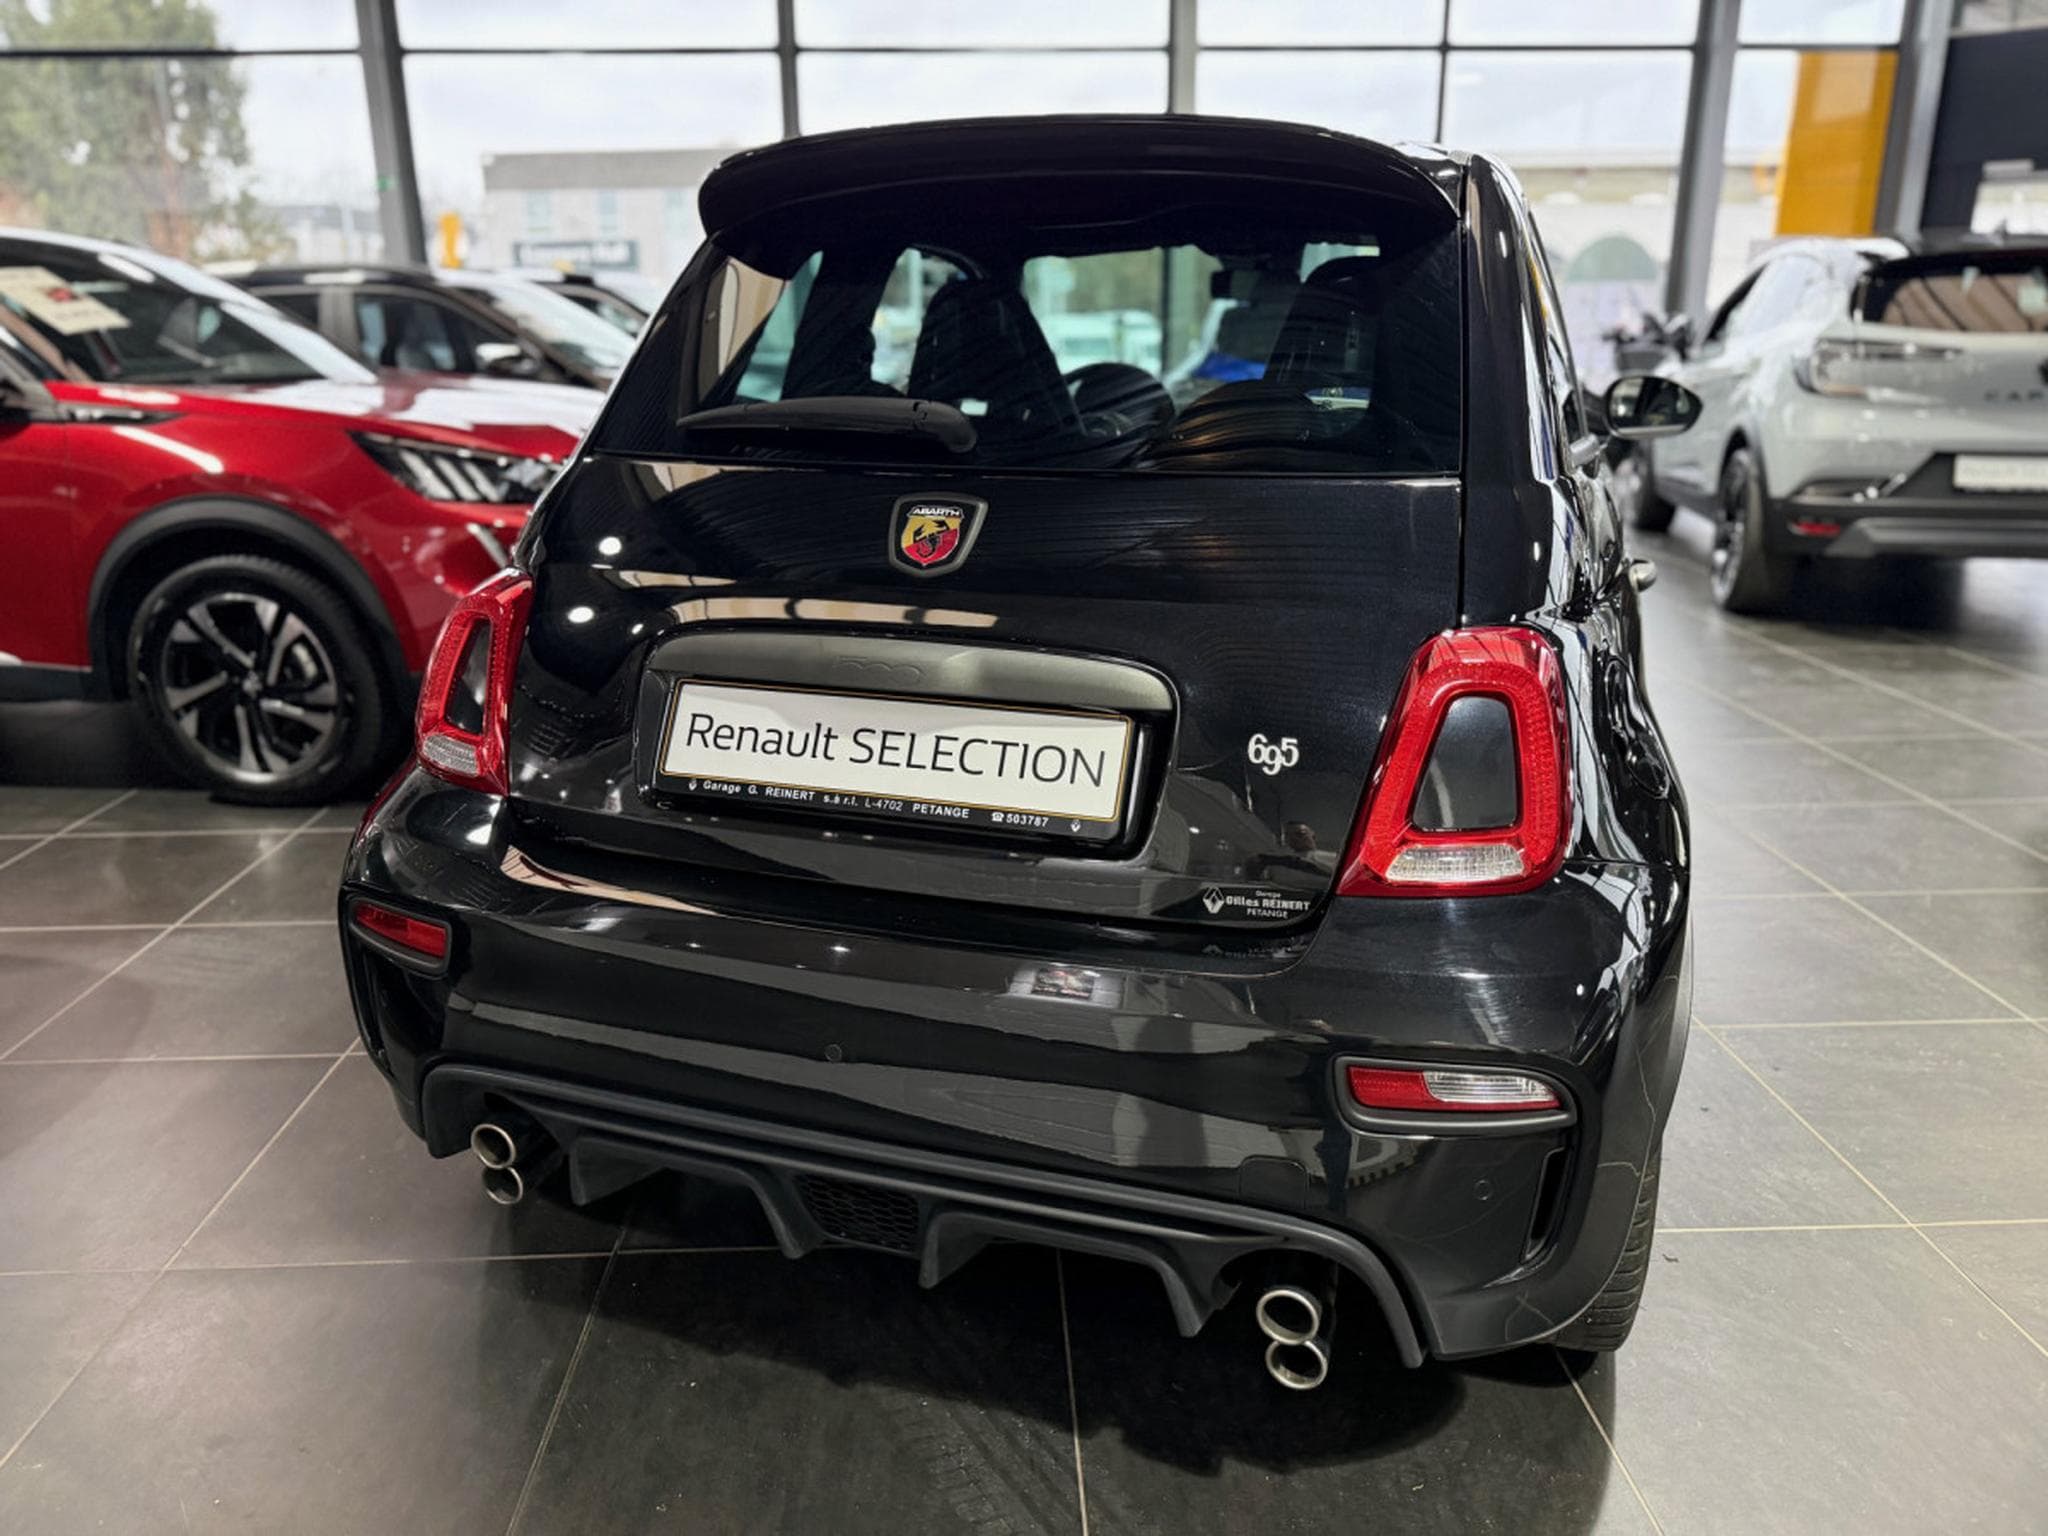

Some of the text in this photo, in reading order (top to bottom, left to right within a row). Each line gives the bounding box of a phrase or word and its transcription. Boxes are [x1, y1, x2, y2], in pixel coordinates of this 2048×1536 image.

[912, 507, 960, 517] ABARTH
[686, 713, 1106, 788] Renault SELECTION
[1247, 733, 1300, 775] 695
[703, 780, 741, 794] Garage
[765, 786, 815, 801] REINERT
[864, 798, 904, 812] L-4702
[912, 803, 970, 819] PETANGE
[1006, 814, 1049, 828] 503787
[1226, 895, 1311, 911] Gilles REINERT
[1247, 907, 1288, 919] PETANGE
